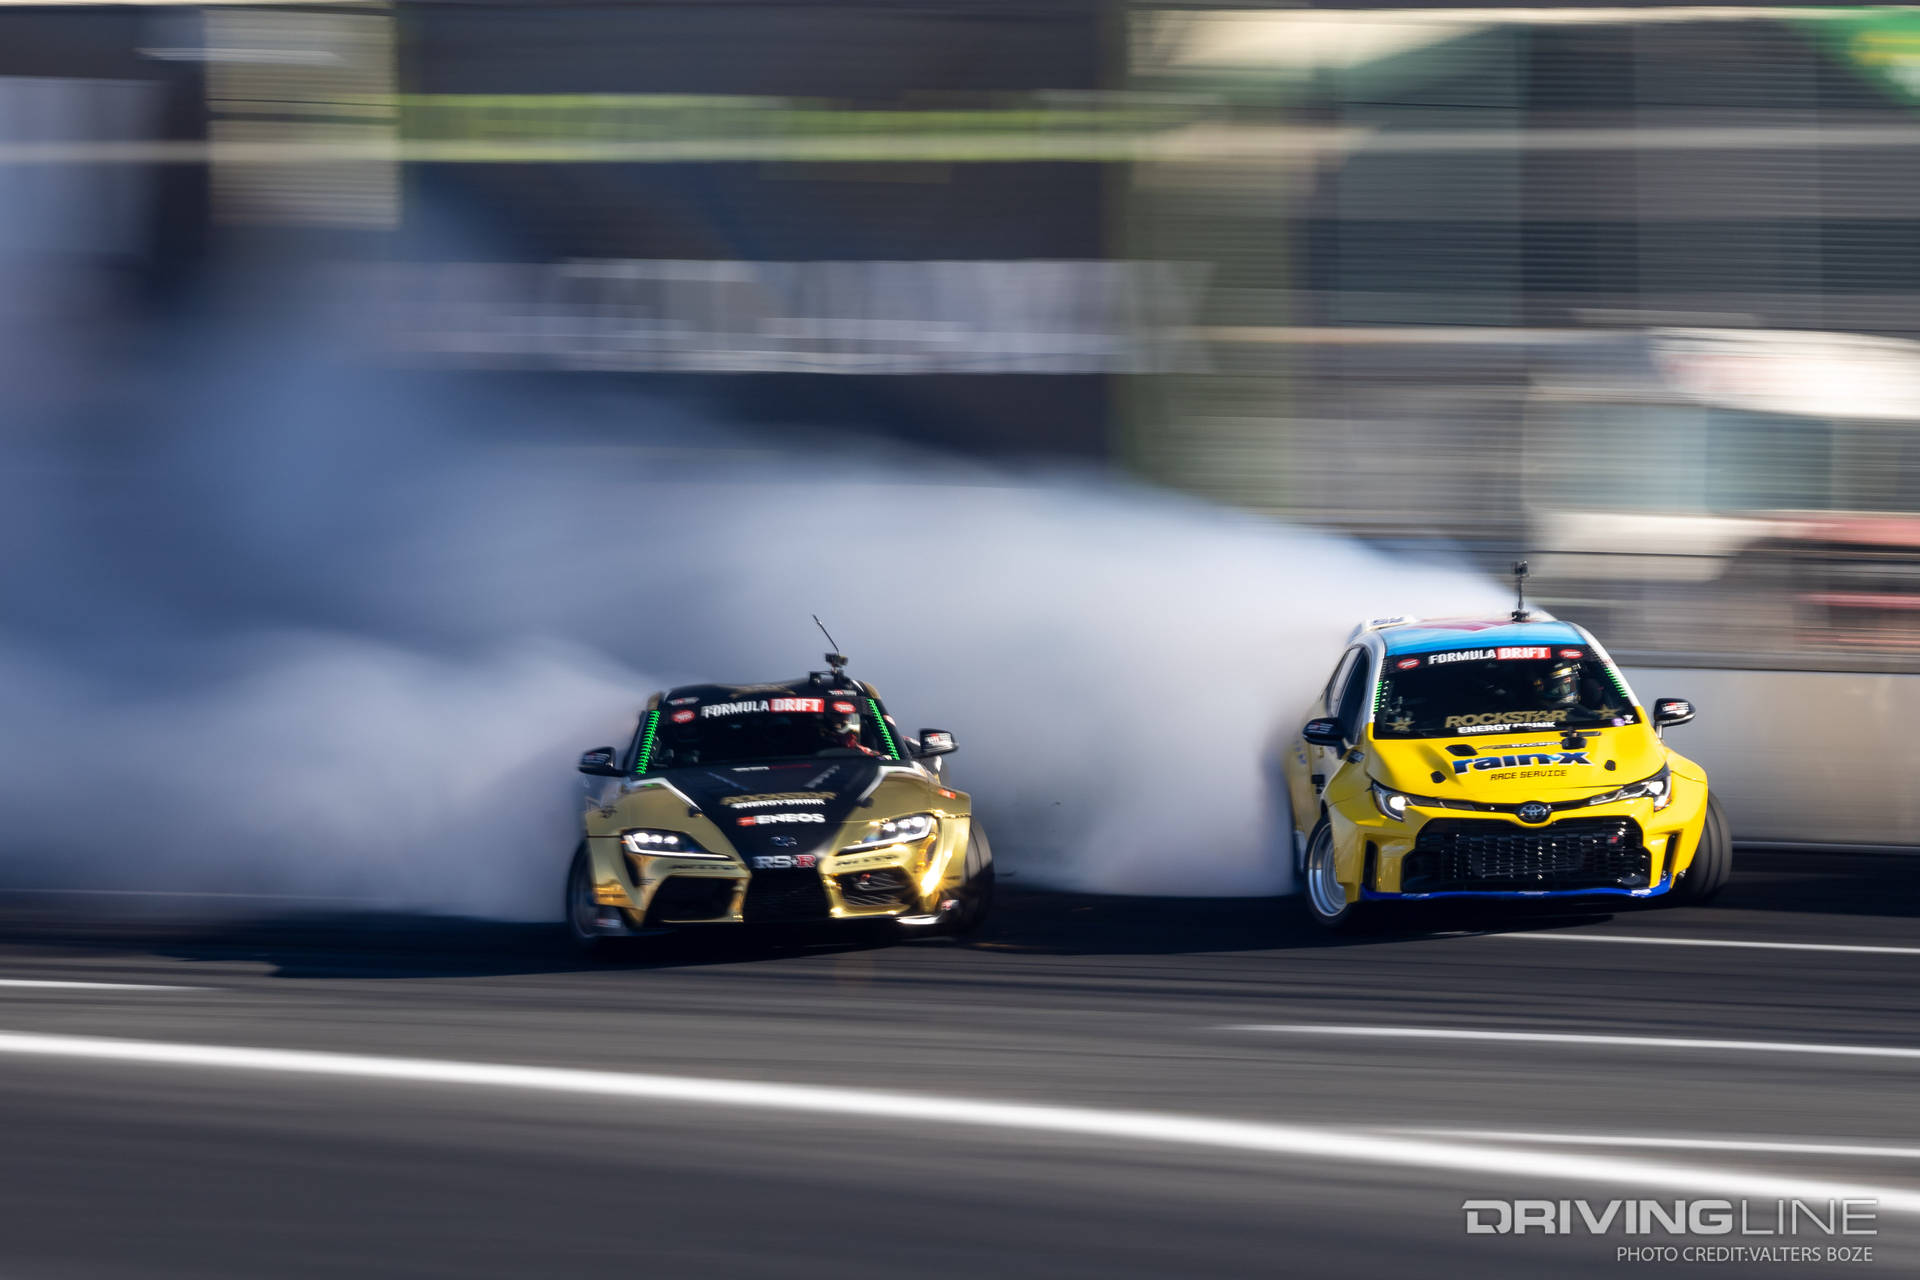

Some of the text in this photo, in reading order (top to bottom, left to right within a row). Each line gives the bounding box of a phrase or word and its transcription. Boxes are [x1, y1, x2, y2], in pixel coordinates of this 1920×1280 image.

[1428, 650, 1496, 665] FORMULA
[1499, 648, 1548, 659] DRIFT
[701, 700, 769, 718] FORMULA
[773, 698, 822, 712] DRIFT
[1445, 710, 1568, 728] ROCKSTAR
[1457, 723, 1511, 734] ENERGY
[1490, 769, 1567, 781] RACE SERVICE
[755, 813, 826, 825] ENEOS
